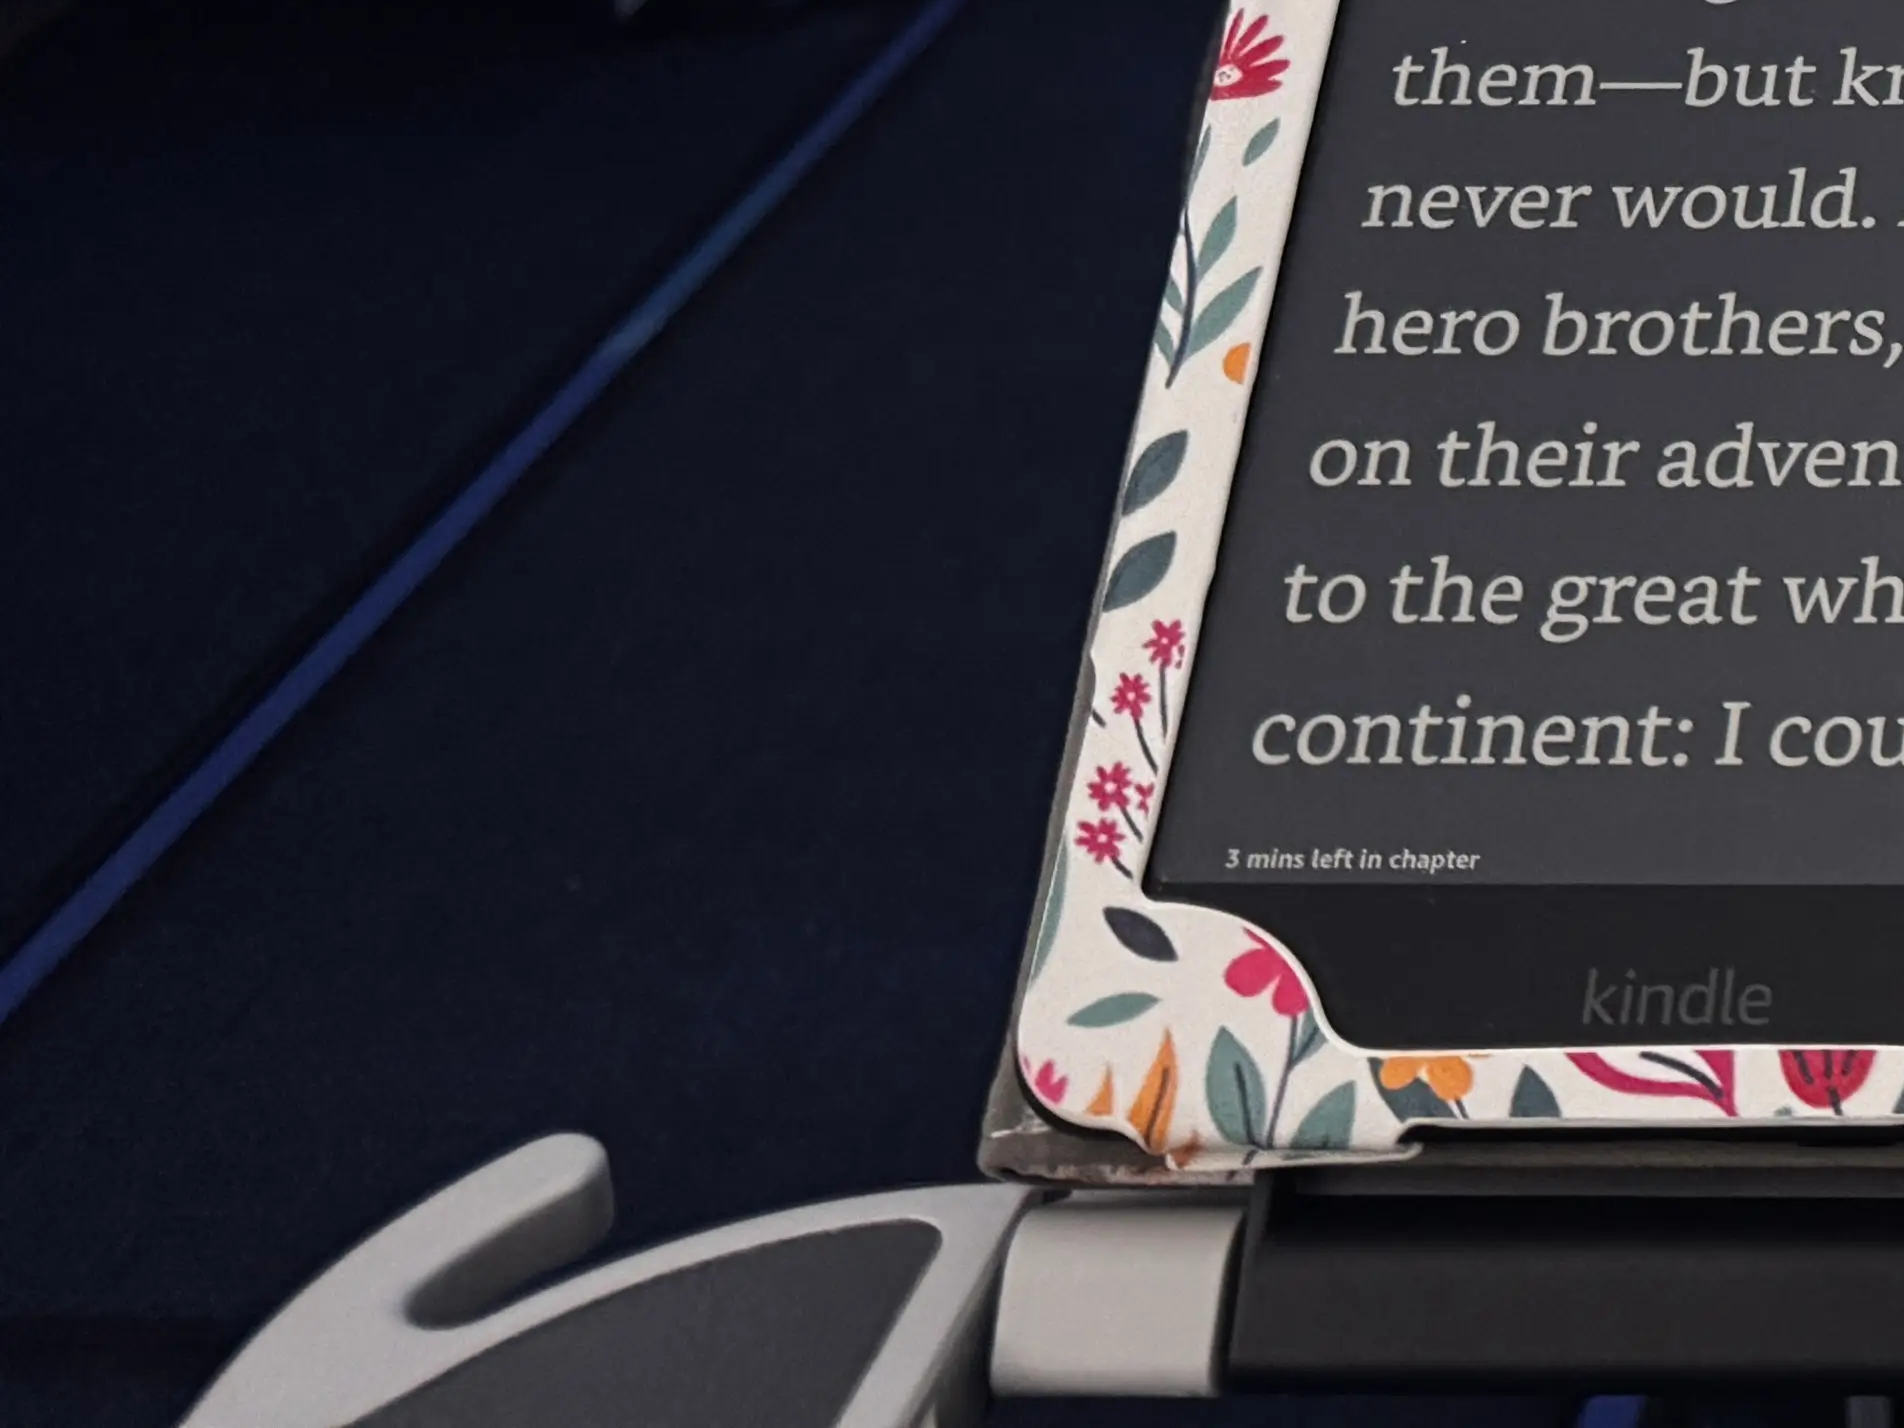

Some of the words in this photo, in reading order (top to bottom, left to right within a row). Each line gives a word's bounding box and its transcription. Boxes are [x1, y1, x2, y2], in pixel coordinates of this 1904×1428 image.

[1362, 185, 1592, 229] never
[1612, 167, 1875, 229] would.
[1334, 291, 1519, 355] hero
[1543, 292, 1902, 368] brothers,
[1310, 439, 1411, 486] on
[1437, 421, 1640, 487] their
[1285, 565, 1366, 623] to
[1390, 555, 1523, 624] the
[1540, 567, 1761, 643] great
[1253, 694, 1693, 766] continent:
[1715, 702, 1751, 765] I
[1225, 849, 1240, 868] 3
[1247, 848, 1304, 868] mins
[1312, 848, 1353, 869] left
[1360, 849, 1382, 869] in
[1389, 849, 1480, 874] chapter
[1583, 968, 1772, 1025] kindle
